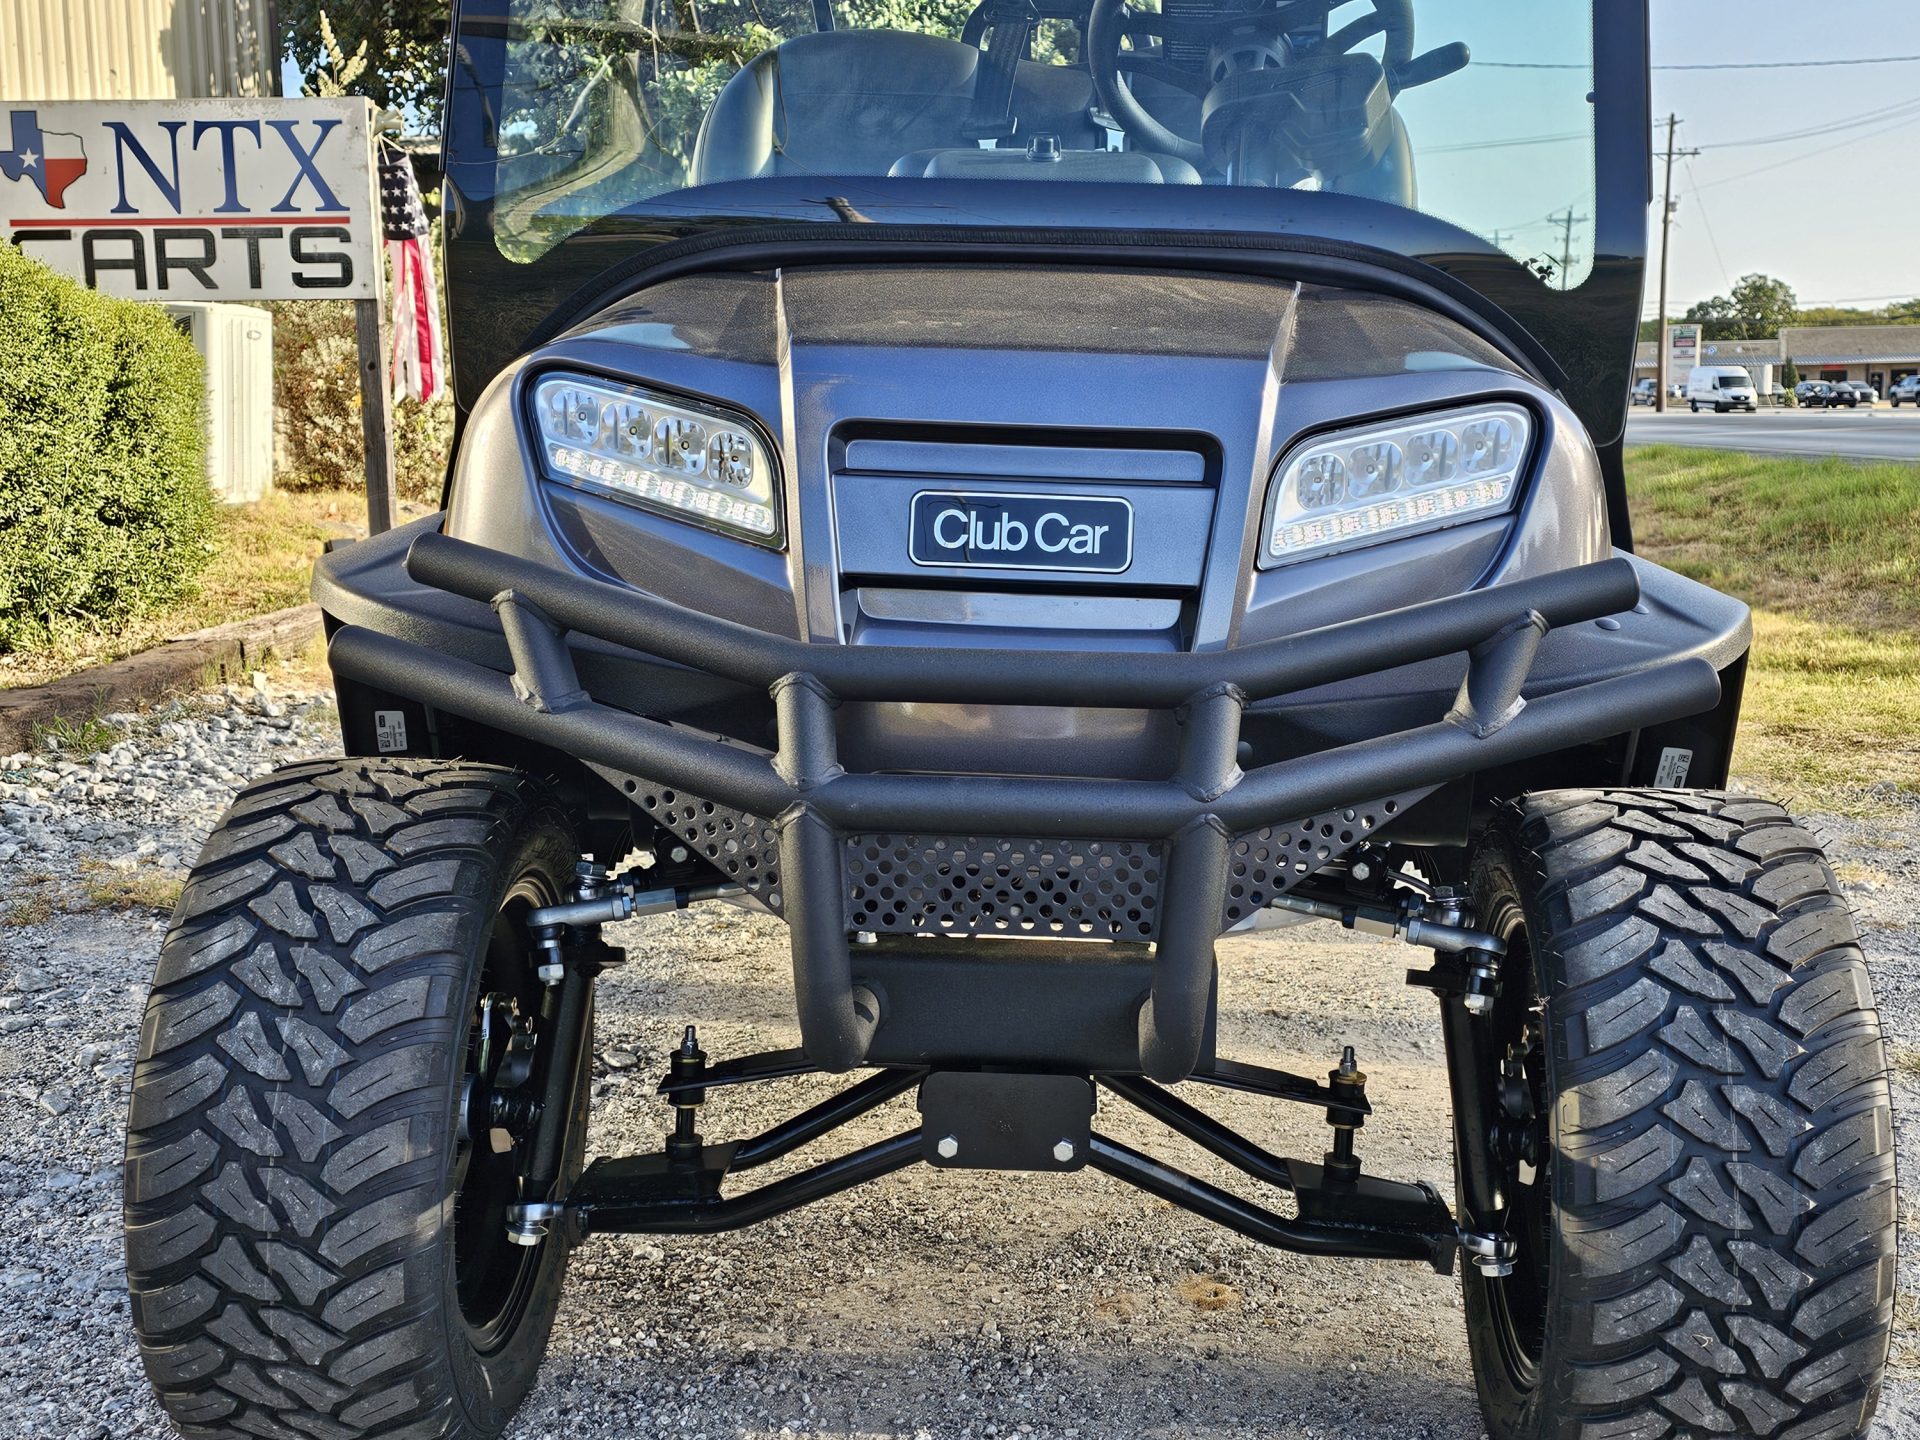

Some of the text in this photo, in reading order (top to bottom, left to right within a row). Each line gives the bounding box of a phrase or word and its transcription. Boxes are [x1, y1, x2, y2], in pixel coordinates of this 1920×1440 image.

[102, 119, 350, 215] NTX
[933, 508, 1109, 554] Club Car
